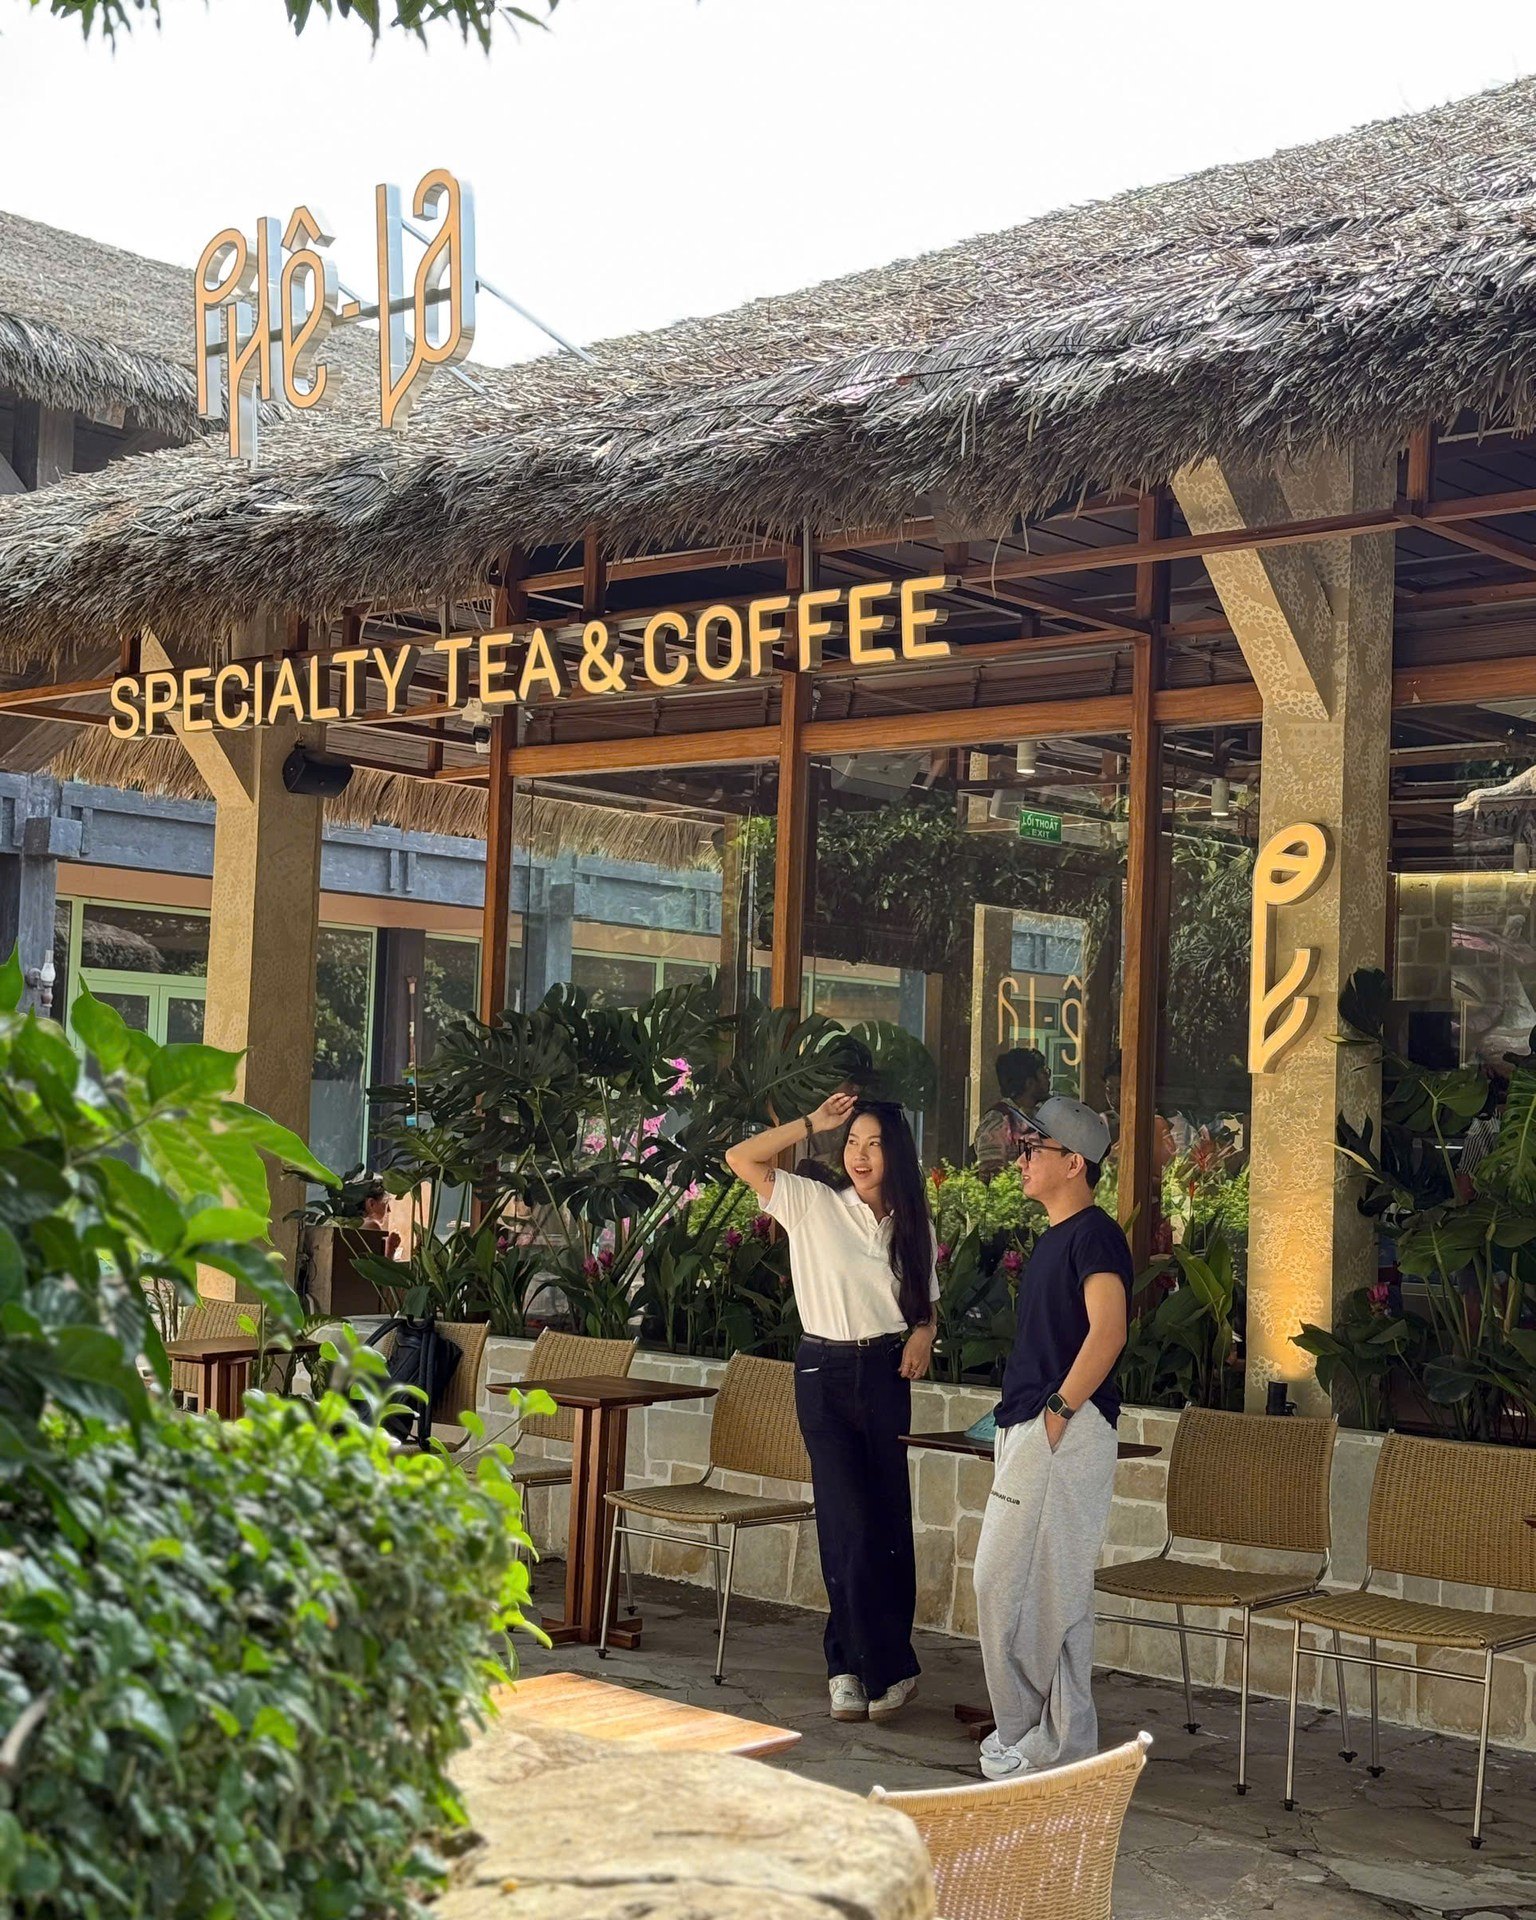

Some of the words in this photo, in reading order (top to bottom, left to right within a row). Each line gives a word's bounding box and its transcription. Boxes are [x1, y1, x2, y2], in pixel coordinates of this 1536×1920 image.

[107, 643, 413, 740] SPECIALTY
[434, 627, 562, 707] TEA
[578, 620, 627, 695] &
[644, 575, 951, 688] COFFEE
[1031, 829, 1050, 839] EXIT
[1006, 1496, 1021, 1506] CLUB
